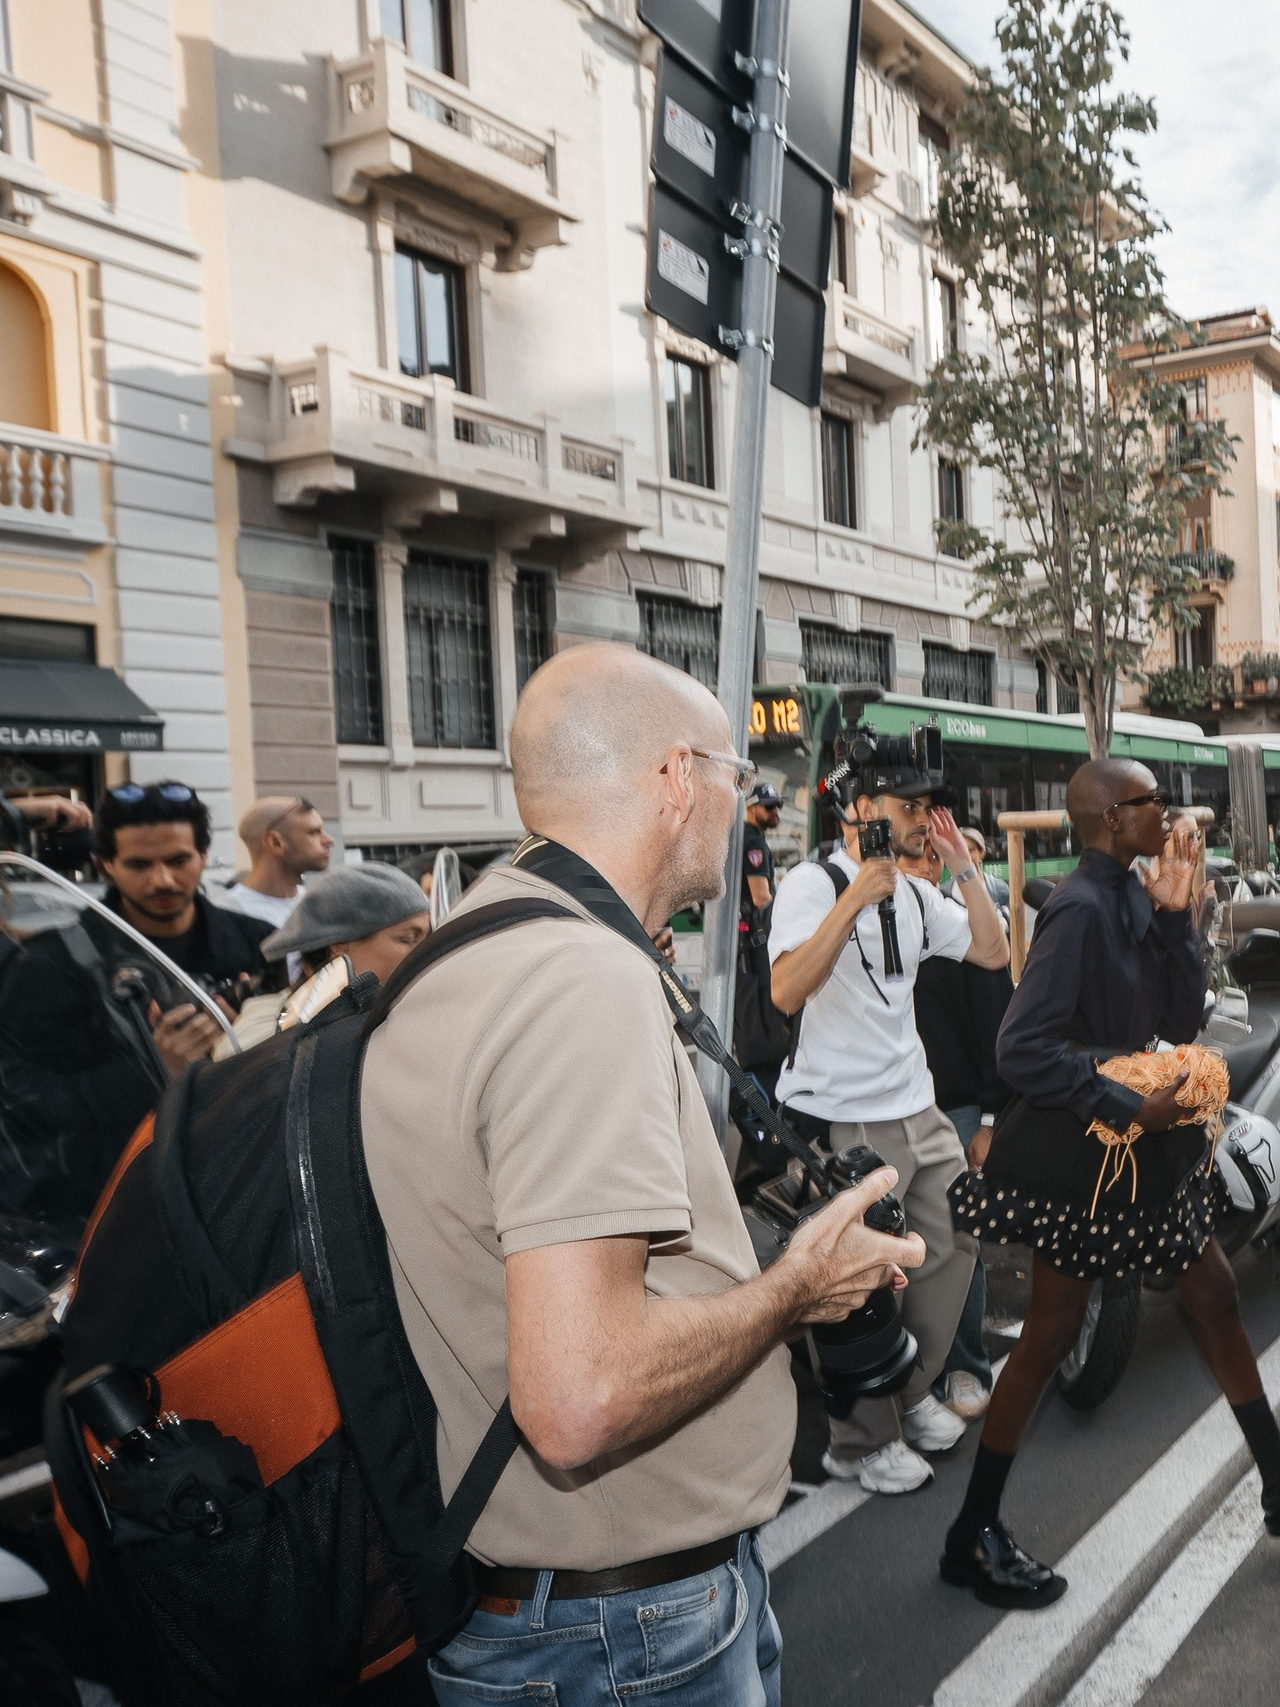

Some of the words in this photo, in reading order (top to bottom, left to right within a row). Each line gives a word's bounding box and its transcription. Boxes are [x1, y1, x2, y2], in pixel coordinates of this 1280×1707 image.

[772, 698, 800, 733] M2
[0, 726, 100, 746] CLASSICA
[824, 759, 851, 790] RONIN
